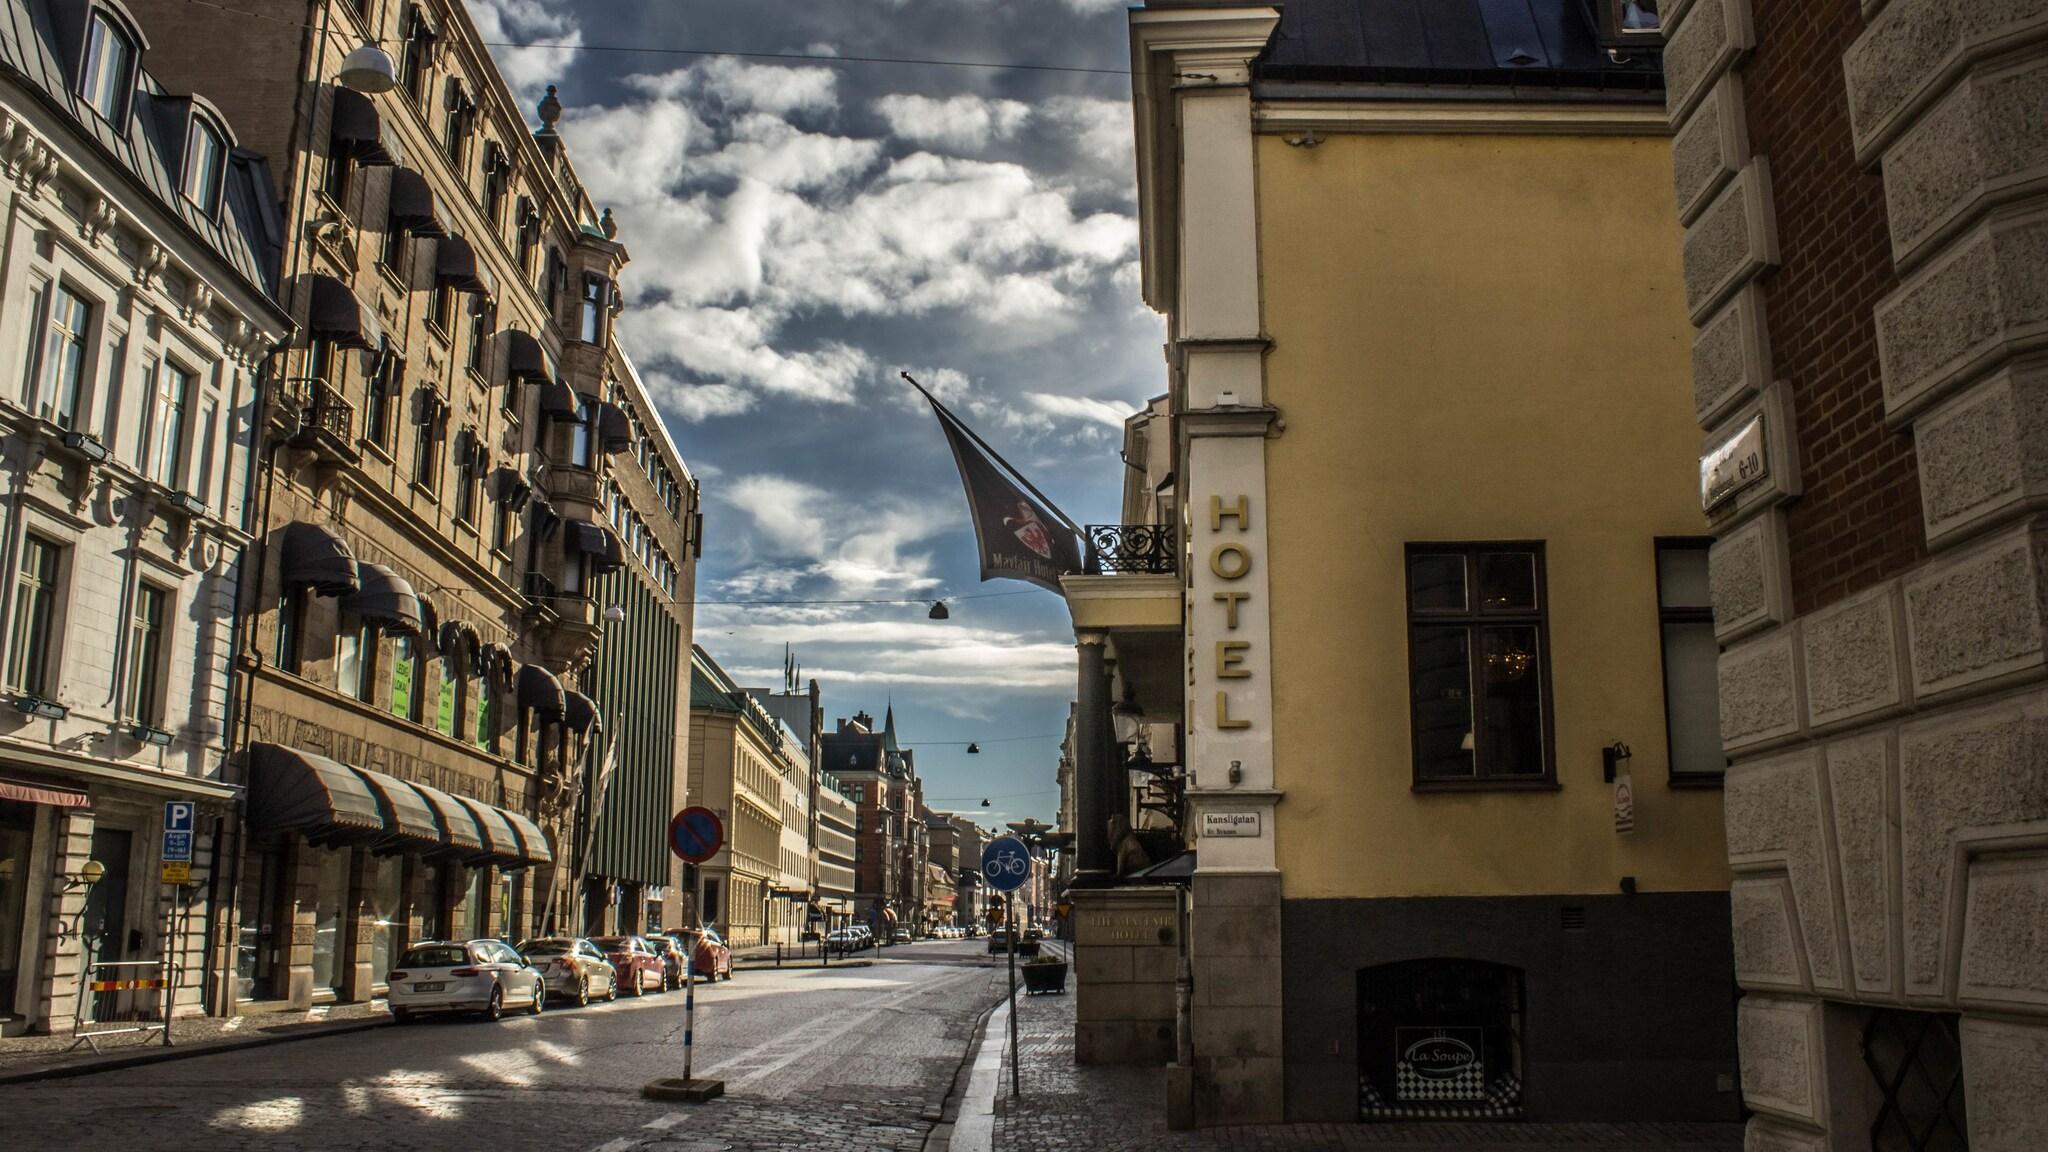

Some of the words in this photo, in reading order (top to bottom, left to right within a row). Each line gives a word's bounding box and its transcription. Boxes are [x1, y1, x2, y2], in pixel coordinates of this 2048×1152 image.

[1738, 451, 1759, 479] 6-10
[992, 552, 1030, 577] Mayfair
[1210, 494, 1252, 729] HOTEL
[171, 804, 188, 828] P
[1206, 815, 1256, 826] Kansligatan
[1411, 1047, 1429, 1062] La
[1431, 1048, 1471, 1065] Soupe
